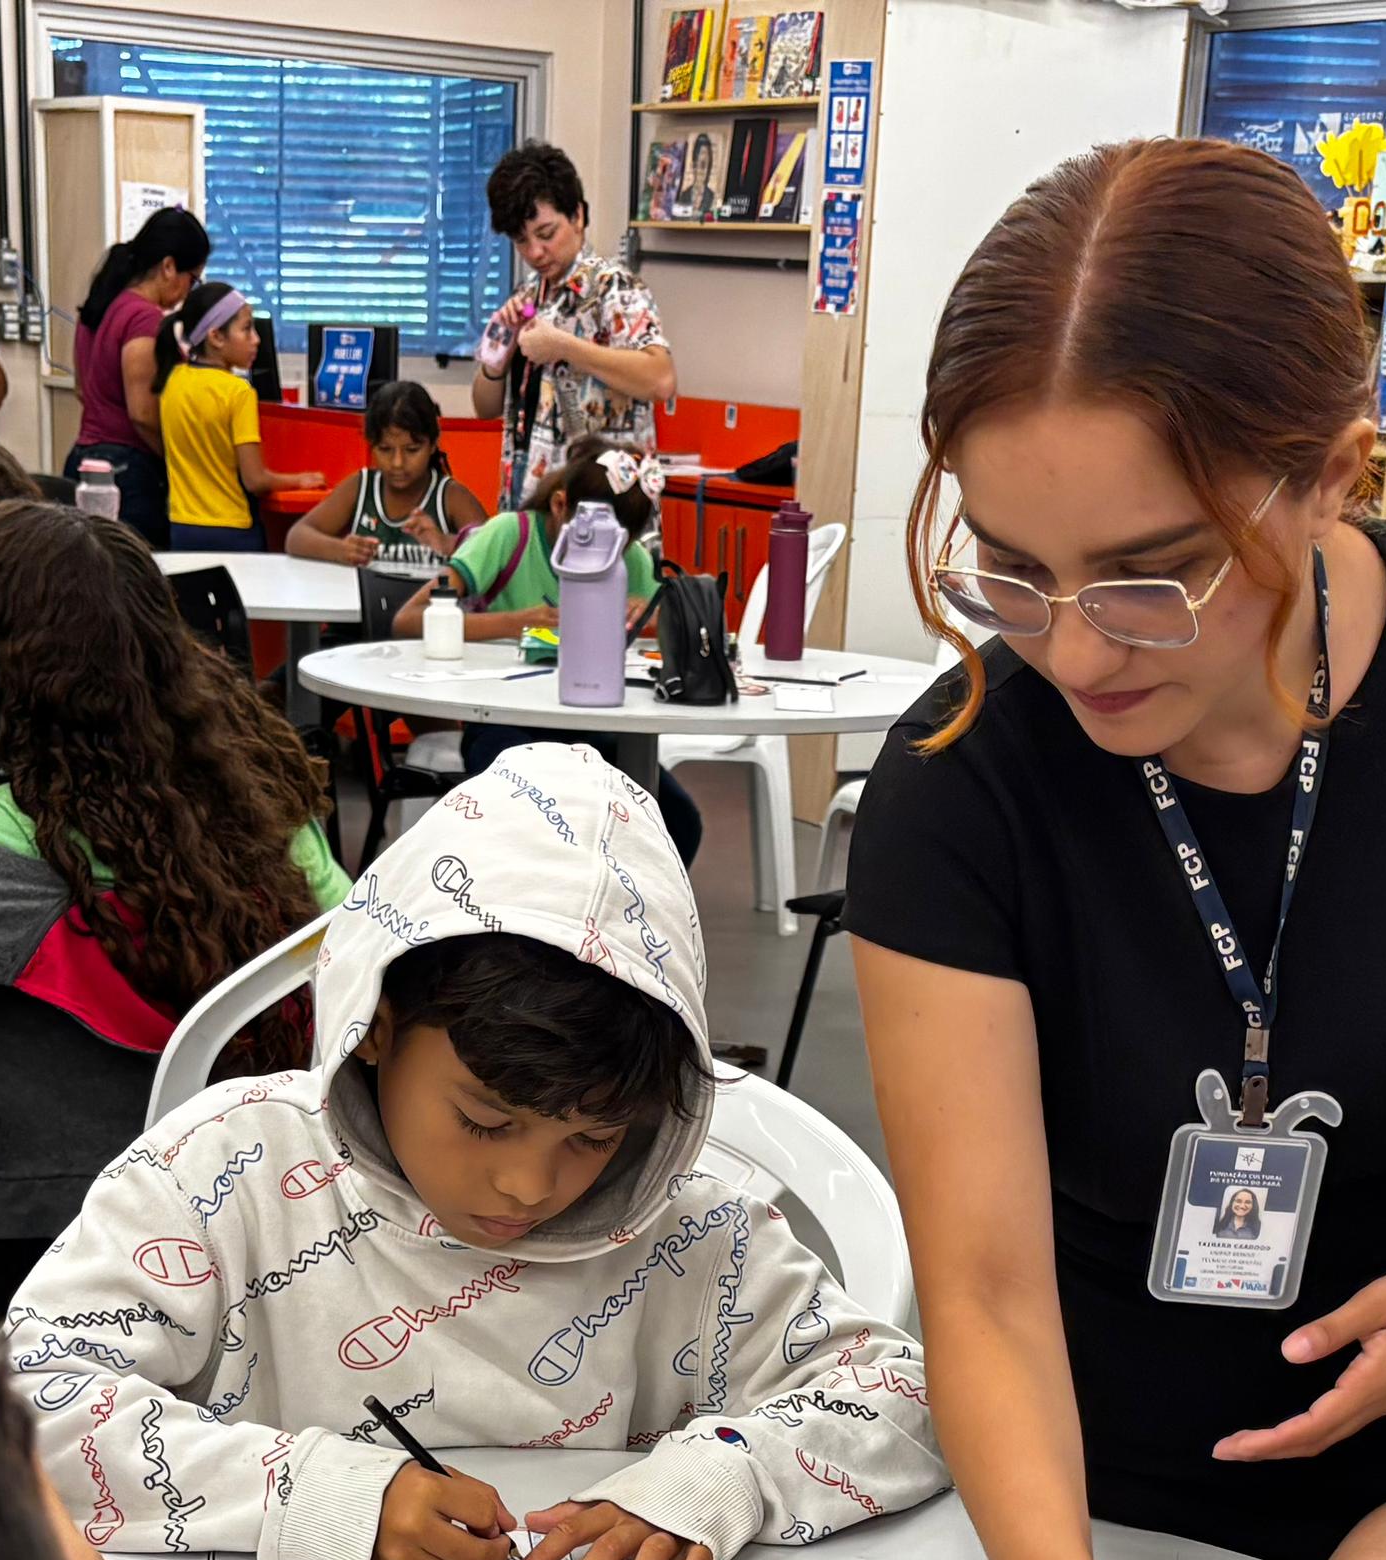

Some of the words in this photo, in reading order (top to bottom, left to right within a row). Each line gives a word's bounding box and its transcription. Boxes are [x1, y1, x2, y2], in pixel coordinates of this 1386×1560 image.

[1143, 761, 1176, 811] FCP
[1299, 740, 1322, 794] FCP
[1177, 842, 1210, 891] FCP
[1286, 829, 1304, 882] FCP
[1210, 922, 1243, 972] FCP
[1242, 1000, 1263, 1029] CP
